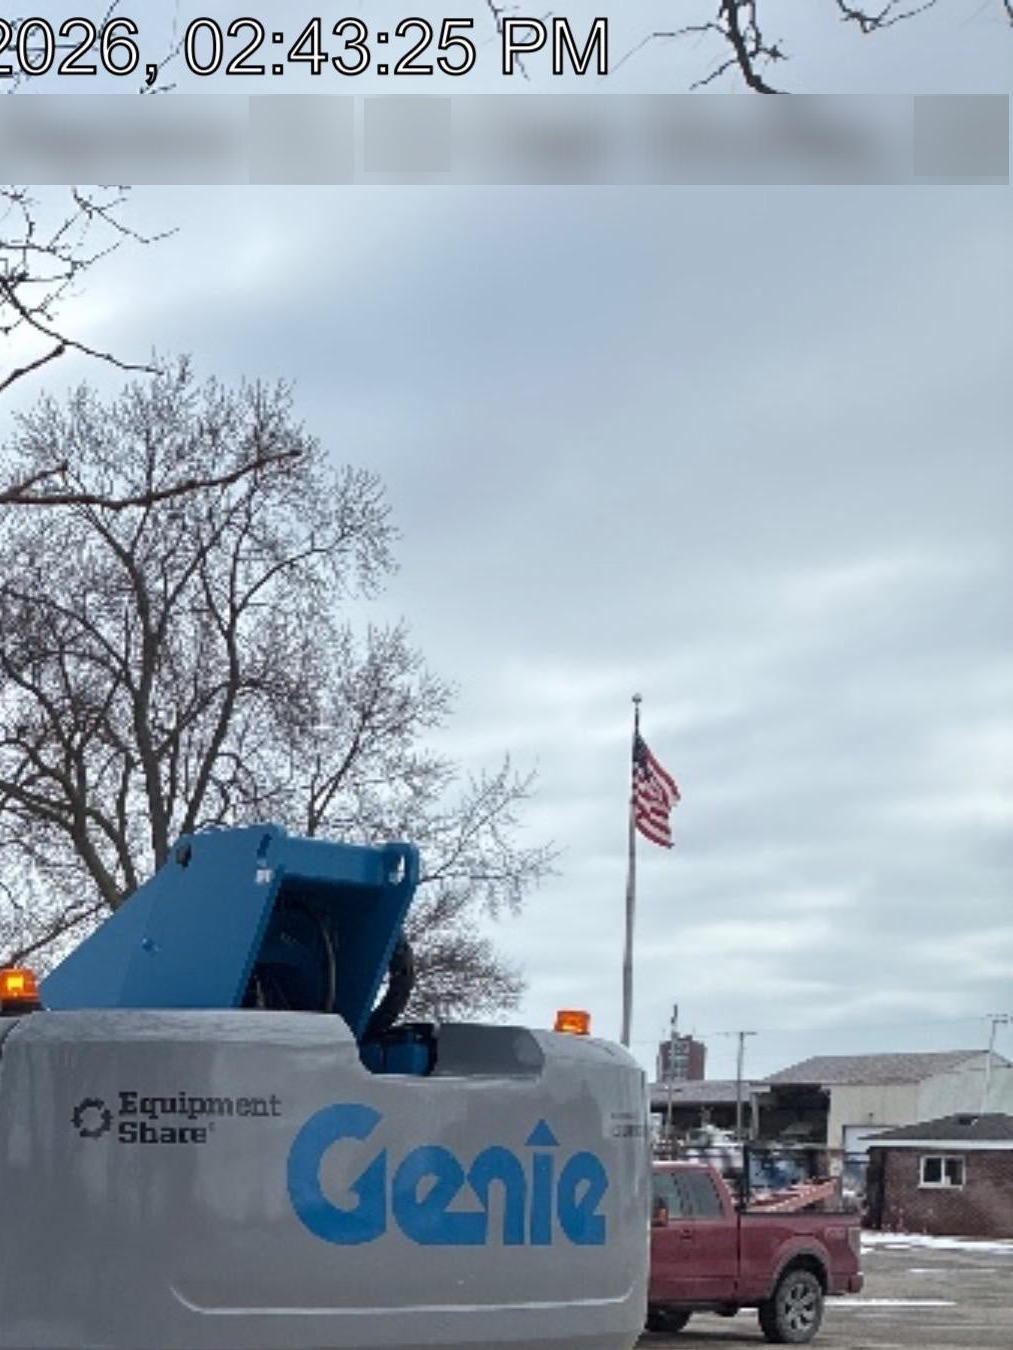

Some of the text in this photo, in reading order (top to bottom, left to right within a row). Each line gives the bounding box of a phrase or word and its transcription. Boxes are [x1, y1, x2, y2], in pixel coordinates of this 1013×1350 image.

[118, 1091, 282, 1120] Equipment
[118, 1121, 207, 1144] Share
[286, 1103, 610, 1246] Genie
